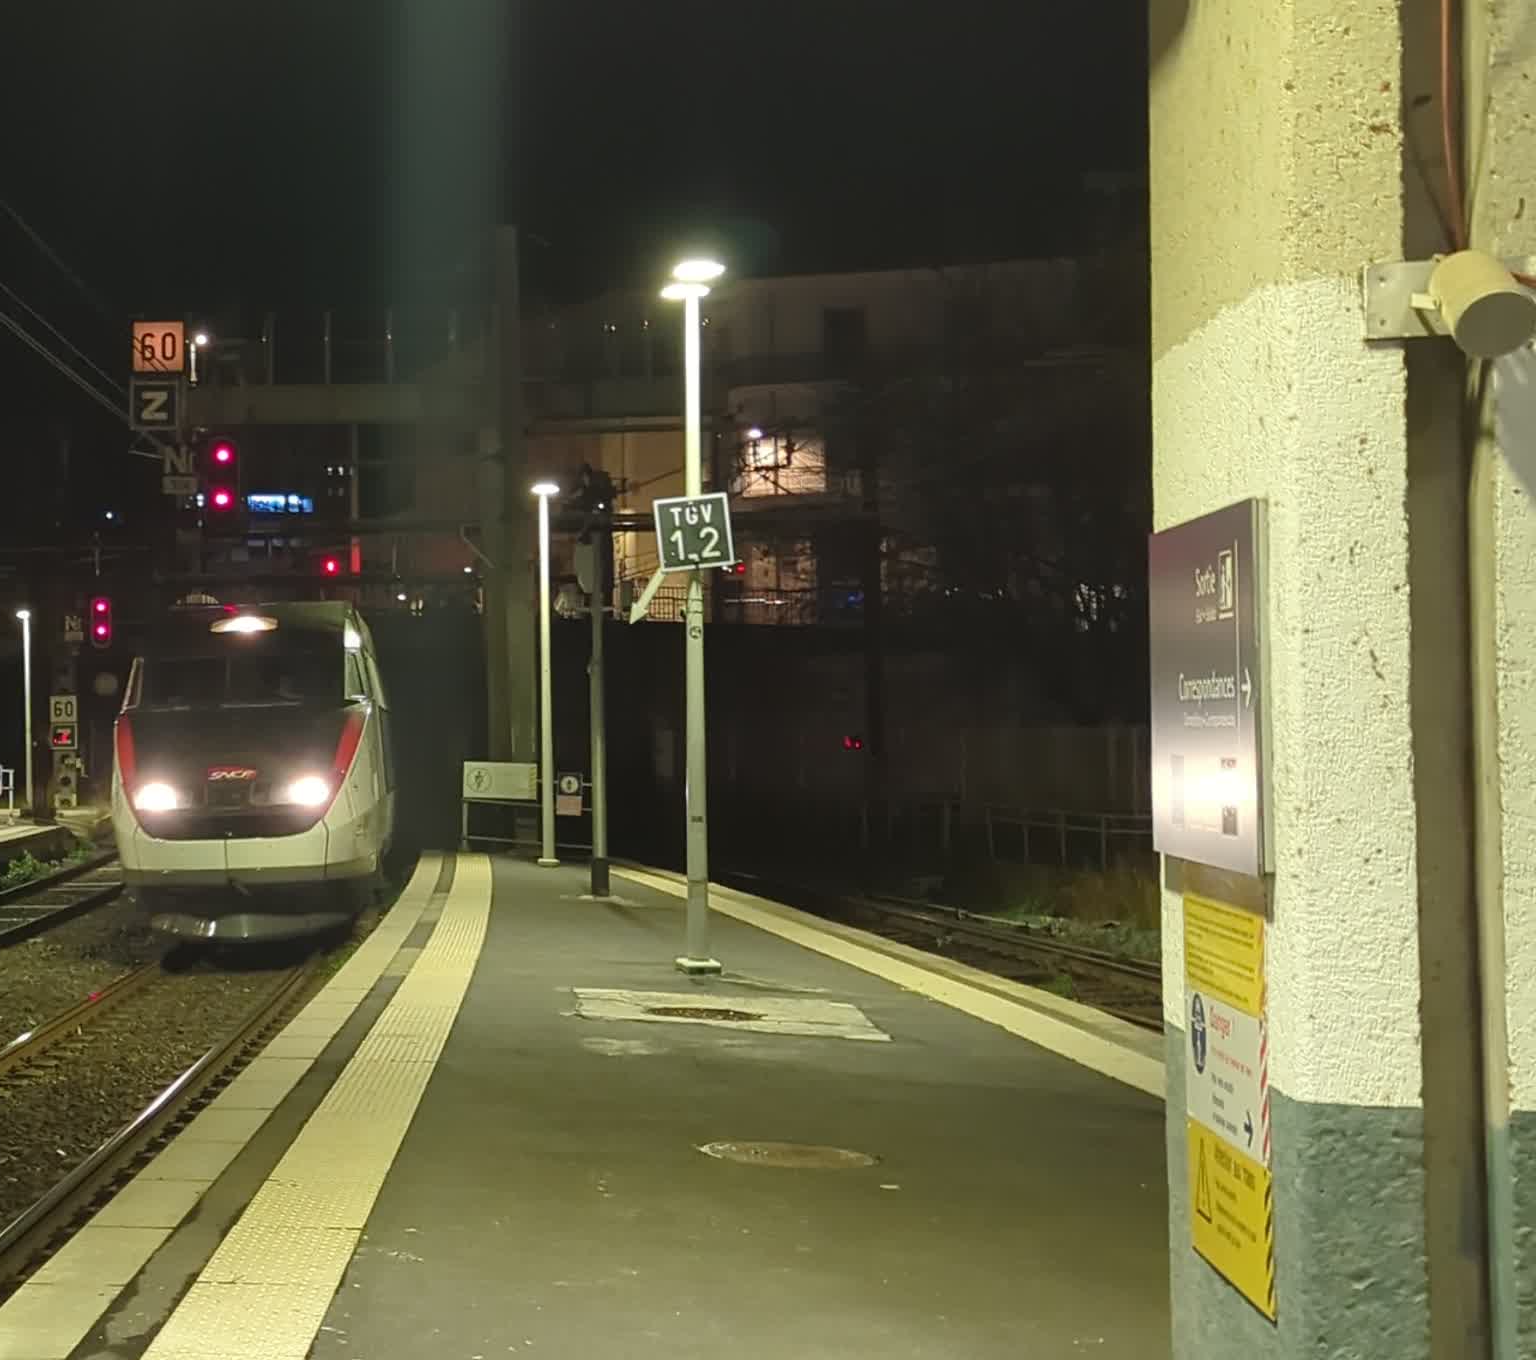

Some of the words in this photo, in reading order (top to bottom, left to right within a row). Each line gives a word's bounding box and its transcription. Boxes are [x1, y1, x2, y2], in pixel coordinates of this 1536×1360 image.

[140, 332, 177, 361] 60
[140, 391, 169, 421] Z
[669, 503, 712, 527] TGV
[53, 701, 74, 717] 60
